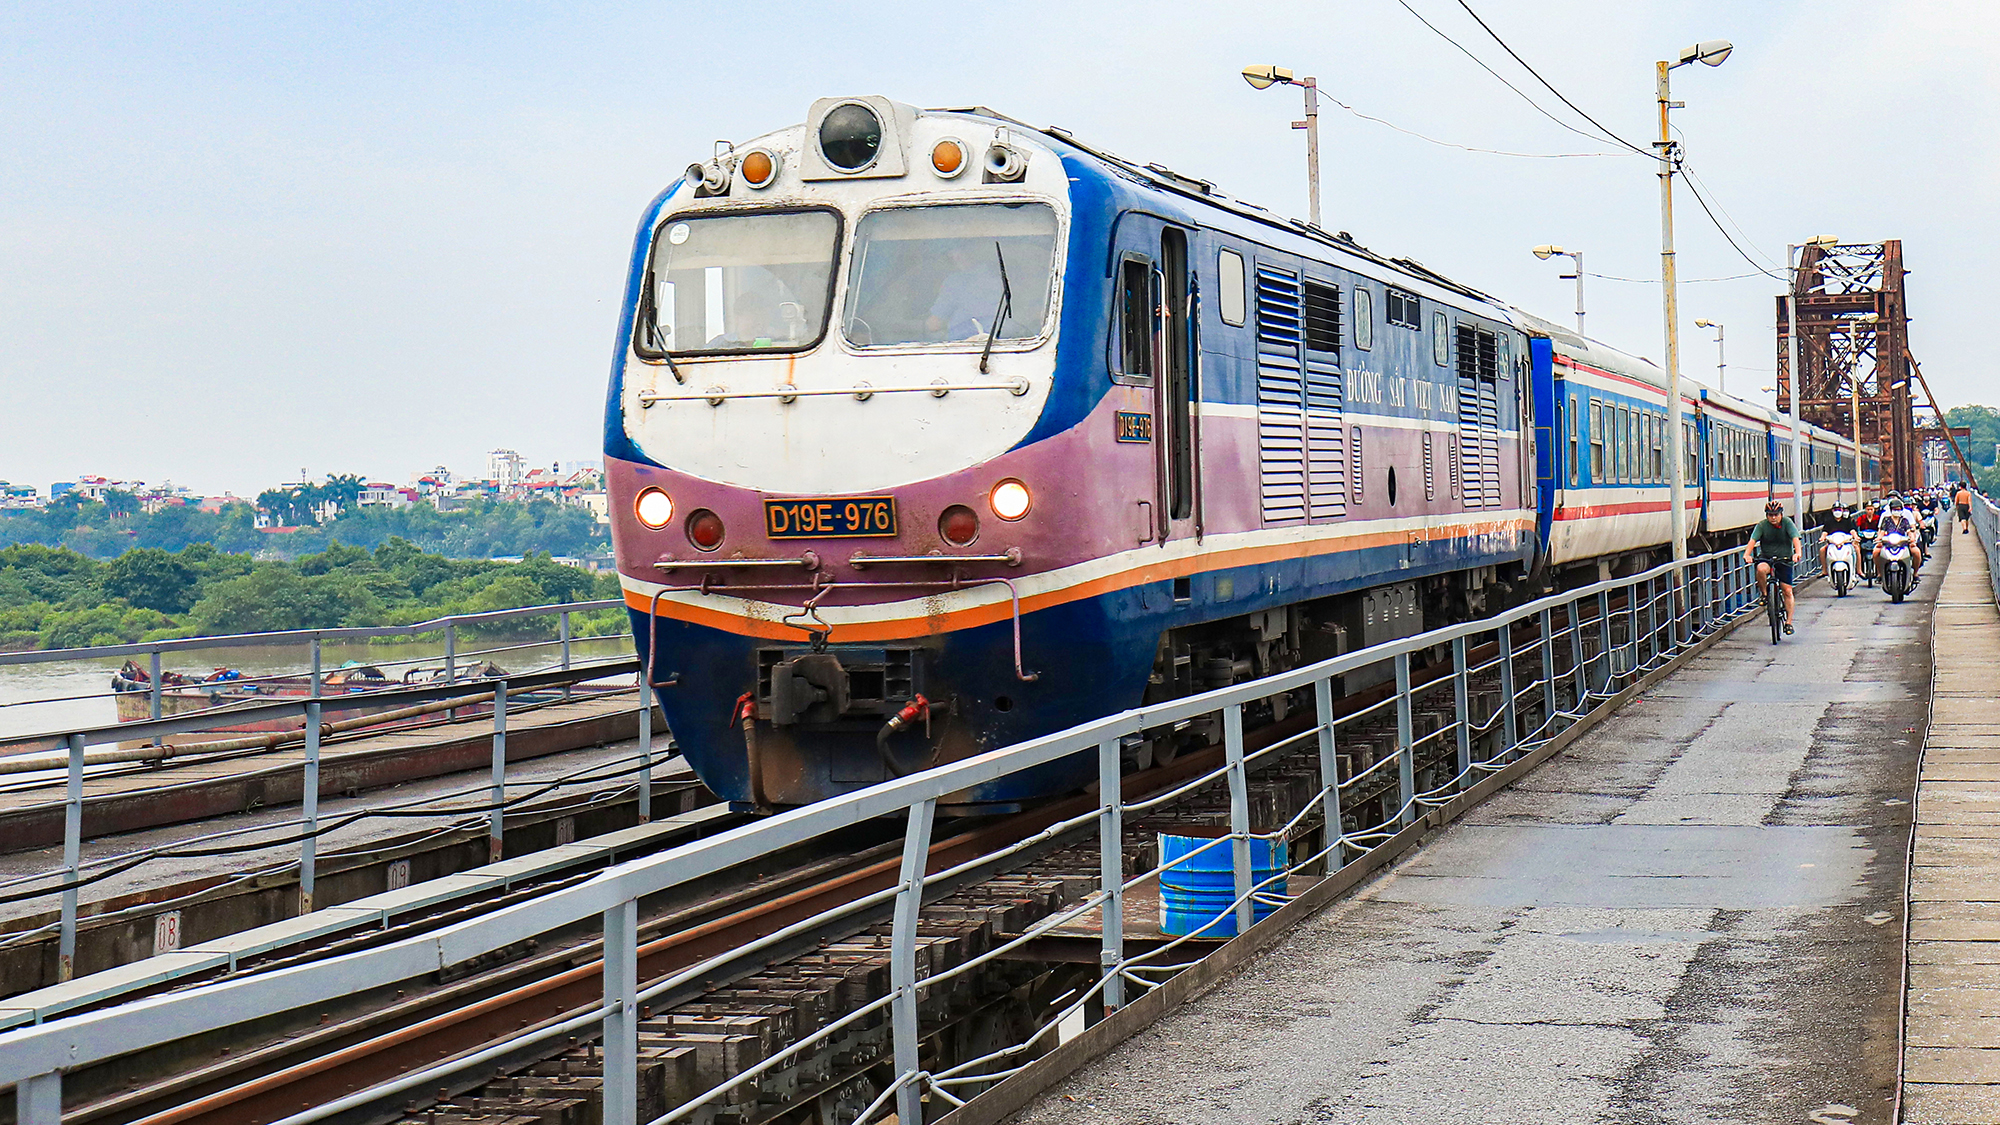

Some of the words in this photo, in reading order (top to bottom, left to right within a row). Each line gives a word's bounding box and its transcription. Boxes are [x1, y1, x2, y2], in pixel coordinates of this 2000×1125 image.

[1346, 361, 1382, 404] ĐƯỜNG
[1439, 384, 1457, 414] NAM
[769, 502, 890, 533] D19E-976
